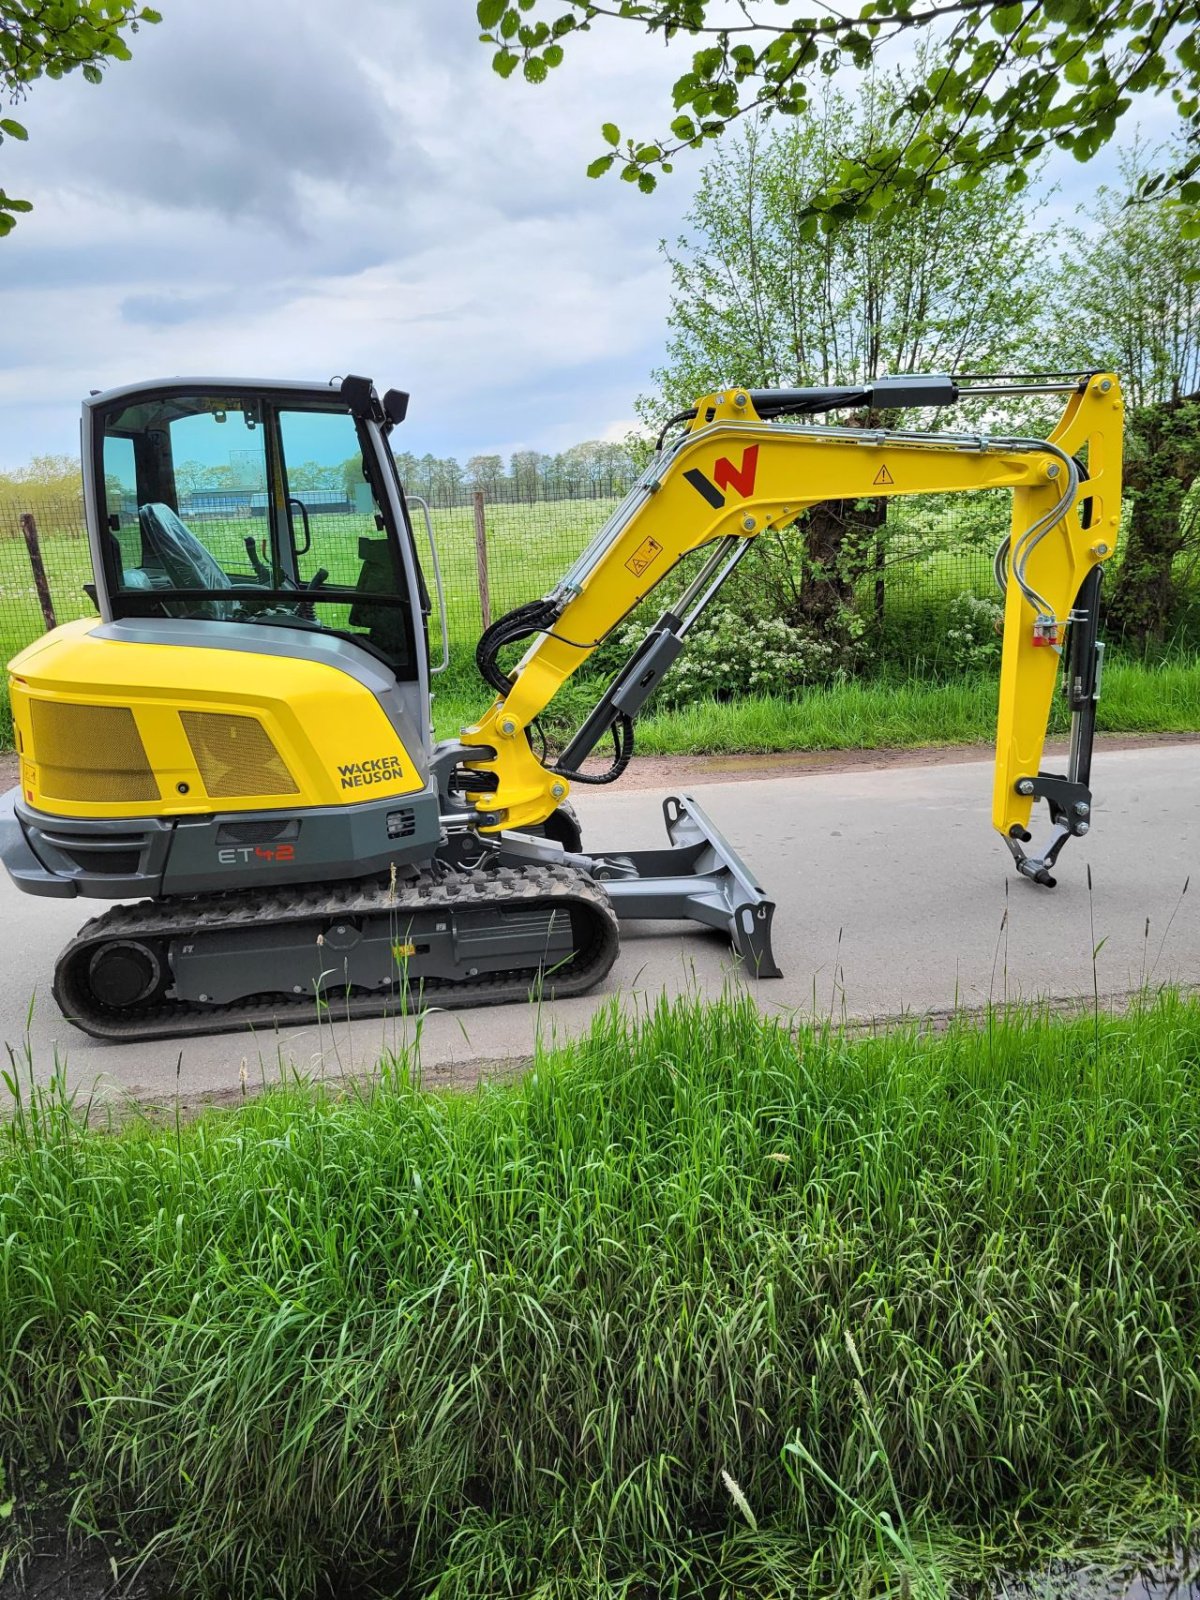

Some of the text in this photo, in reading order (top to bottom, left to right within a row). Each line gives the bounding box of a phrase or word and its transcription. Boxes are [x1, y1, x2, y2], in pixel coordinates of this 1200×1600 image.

[337, 756, 401, 777] WACKER
[341, 767, 404, 790] NEUSON
[218, 844, 295, 864] ET42
